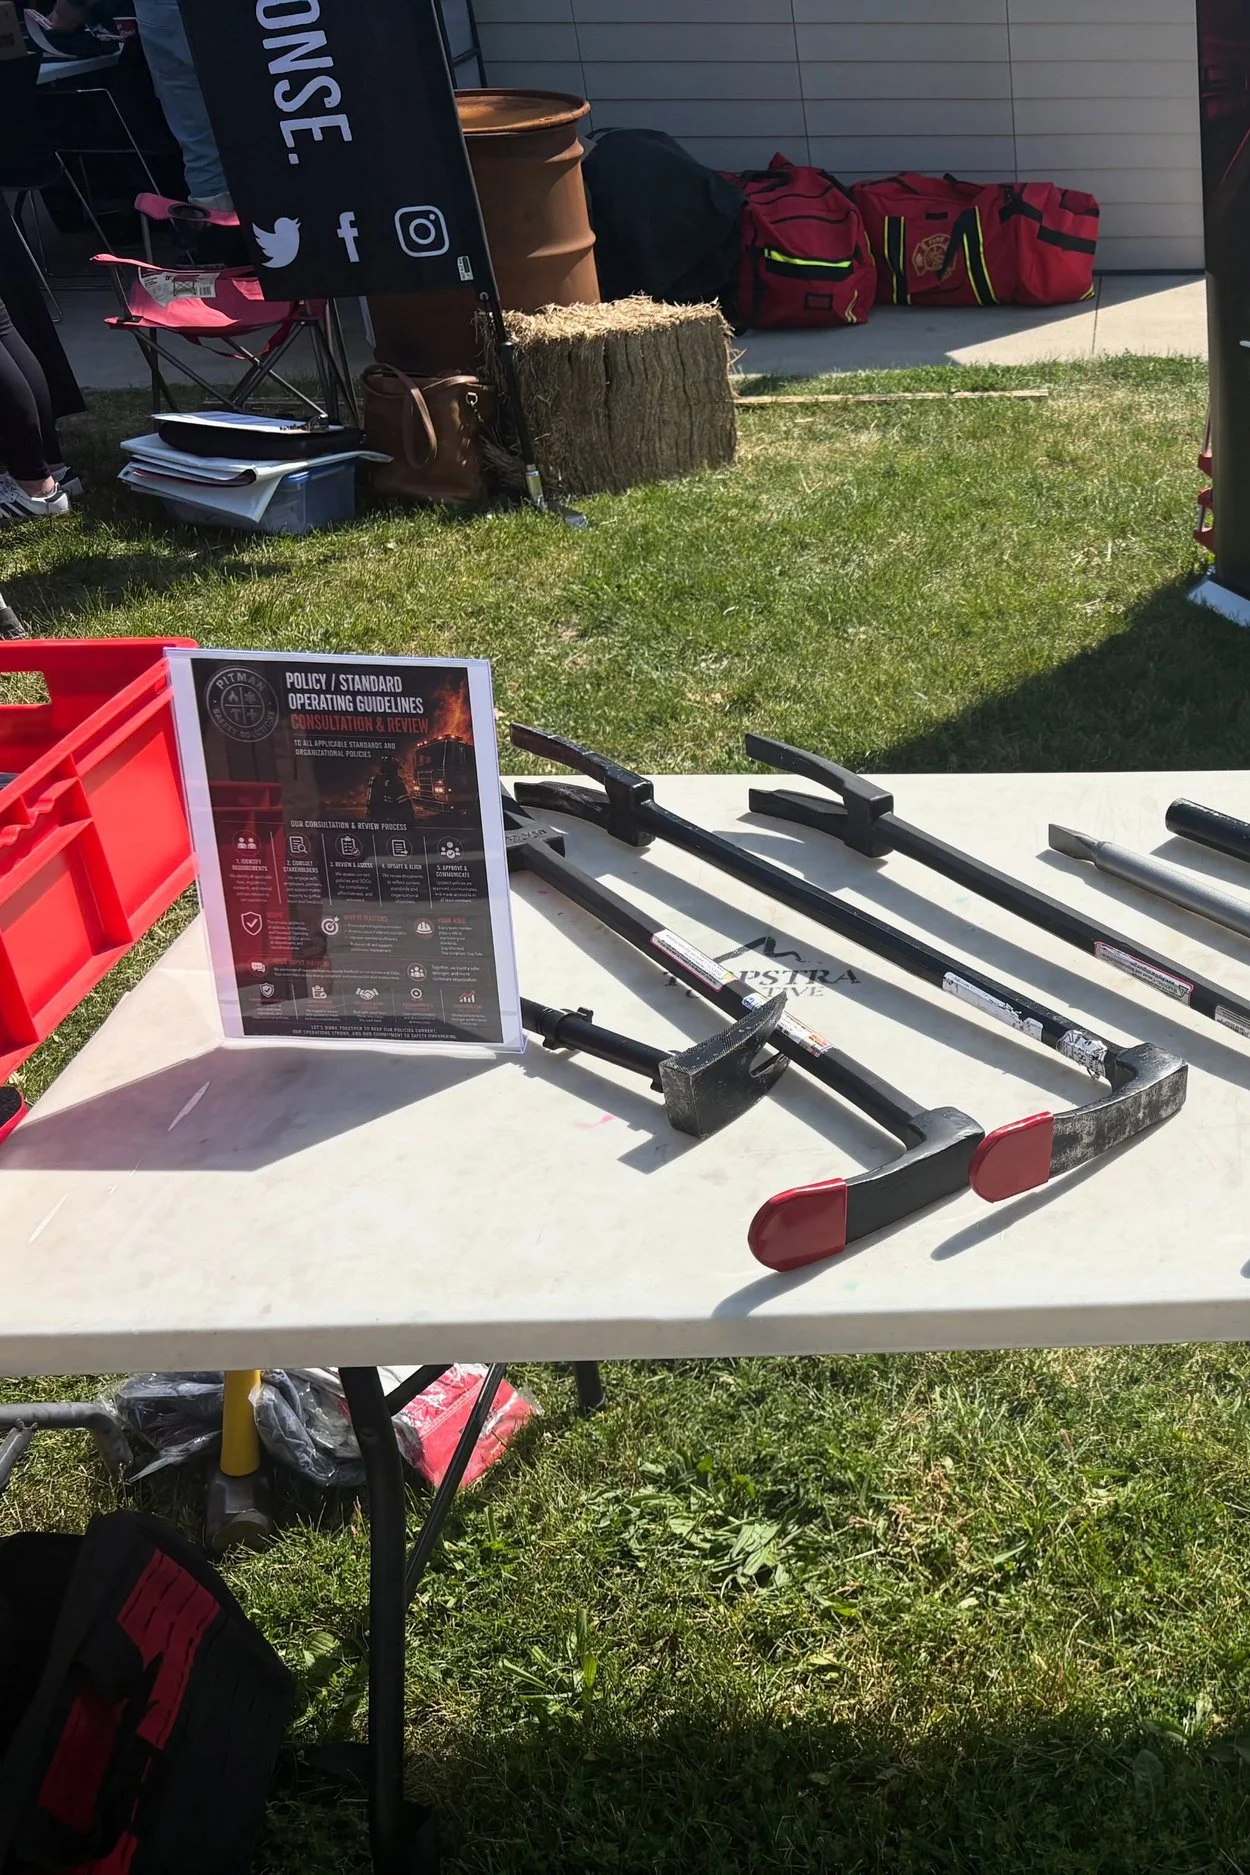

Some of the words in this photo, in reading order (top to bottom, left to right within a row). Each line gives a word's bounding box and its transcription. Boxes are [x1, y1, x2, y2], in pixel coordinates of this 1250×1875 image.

[214, 671, 266, 690] PITMAN
[285, 672, 327, 690] POLICY
[329, 673, 337, 690] /
[339, 674, 402, 693] STANDARD
[287, 693, 353, 711] OPERATING
[355, 695, 424, 713] GUIDELINES
[290, 714, 373, 732] CONSULTATION
[375, 716, 384, 732] &
[386, 717, 429, 733] REVIEW
[295, 749, 344, 757] ORGANIZATIONAL
[314, 740, 347, 748] APPLICABLE
[348, 741, 383, 749] STANDARDS
